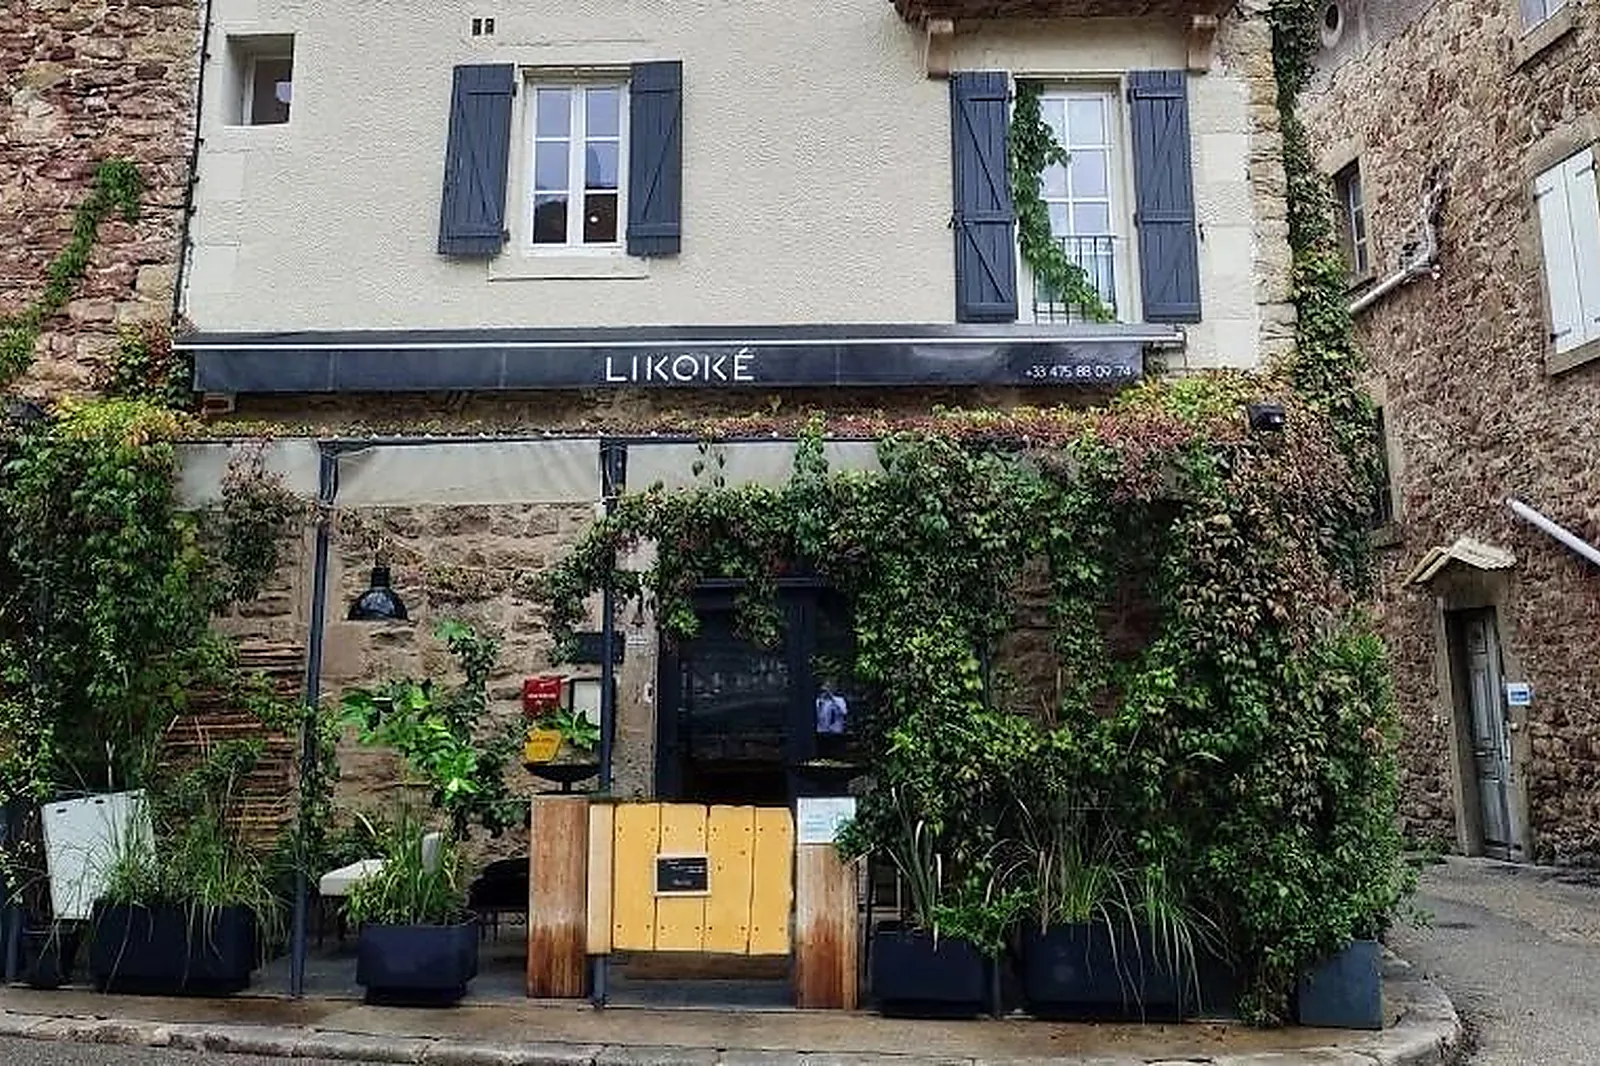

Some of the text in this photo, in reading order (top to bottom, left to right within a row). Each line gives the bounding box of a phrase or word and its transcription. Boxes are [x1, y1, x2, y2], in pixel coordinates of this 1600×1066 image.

[605, 346, 755, 382] LIKOKÉ
[1026, 365, 1047, 378] +33
[1049, 365, 1073, 377] 475
